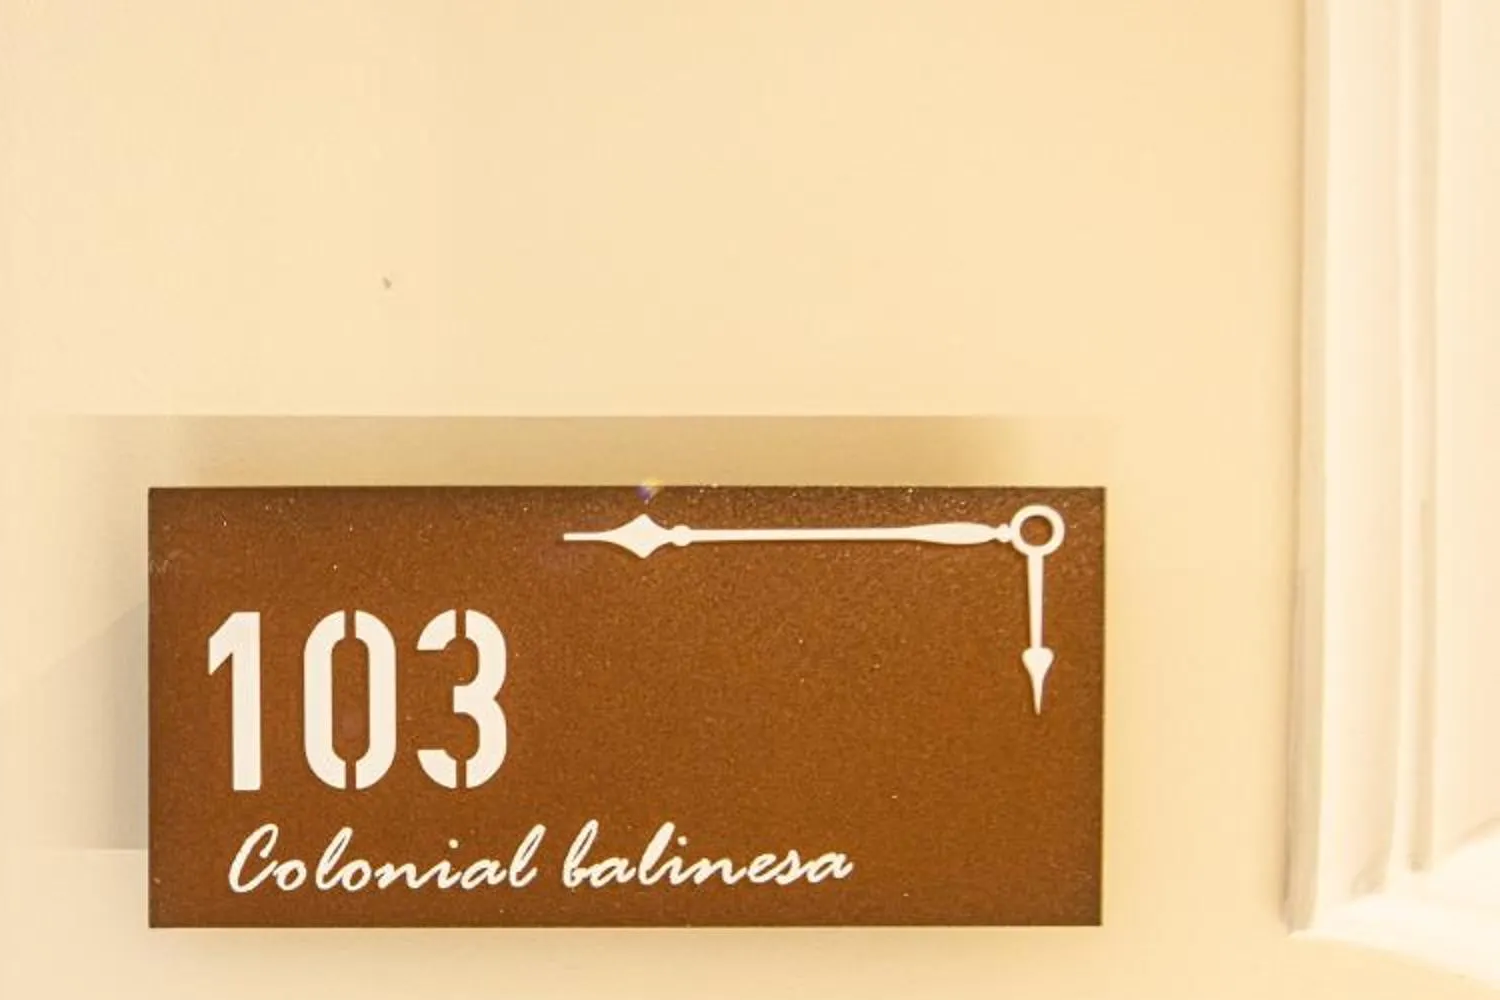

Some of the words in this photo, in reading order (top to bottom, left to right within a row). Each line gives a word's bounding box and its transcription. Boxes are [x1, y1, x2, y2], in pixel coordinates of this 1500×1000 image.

[208, 609, 508, 791] 103
[227, 823, 546, 893] Colonial
[562, 819, 853, 888] balinesa
